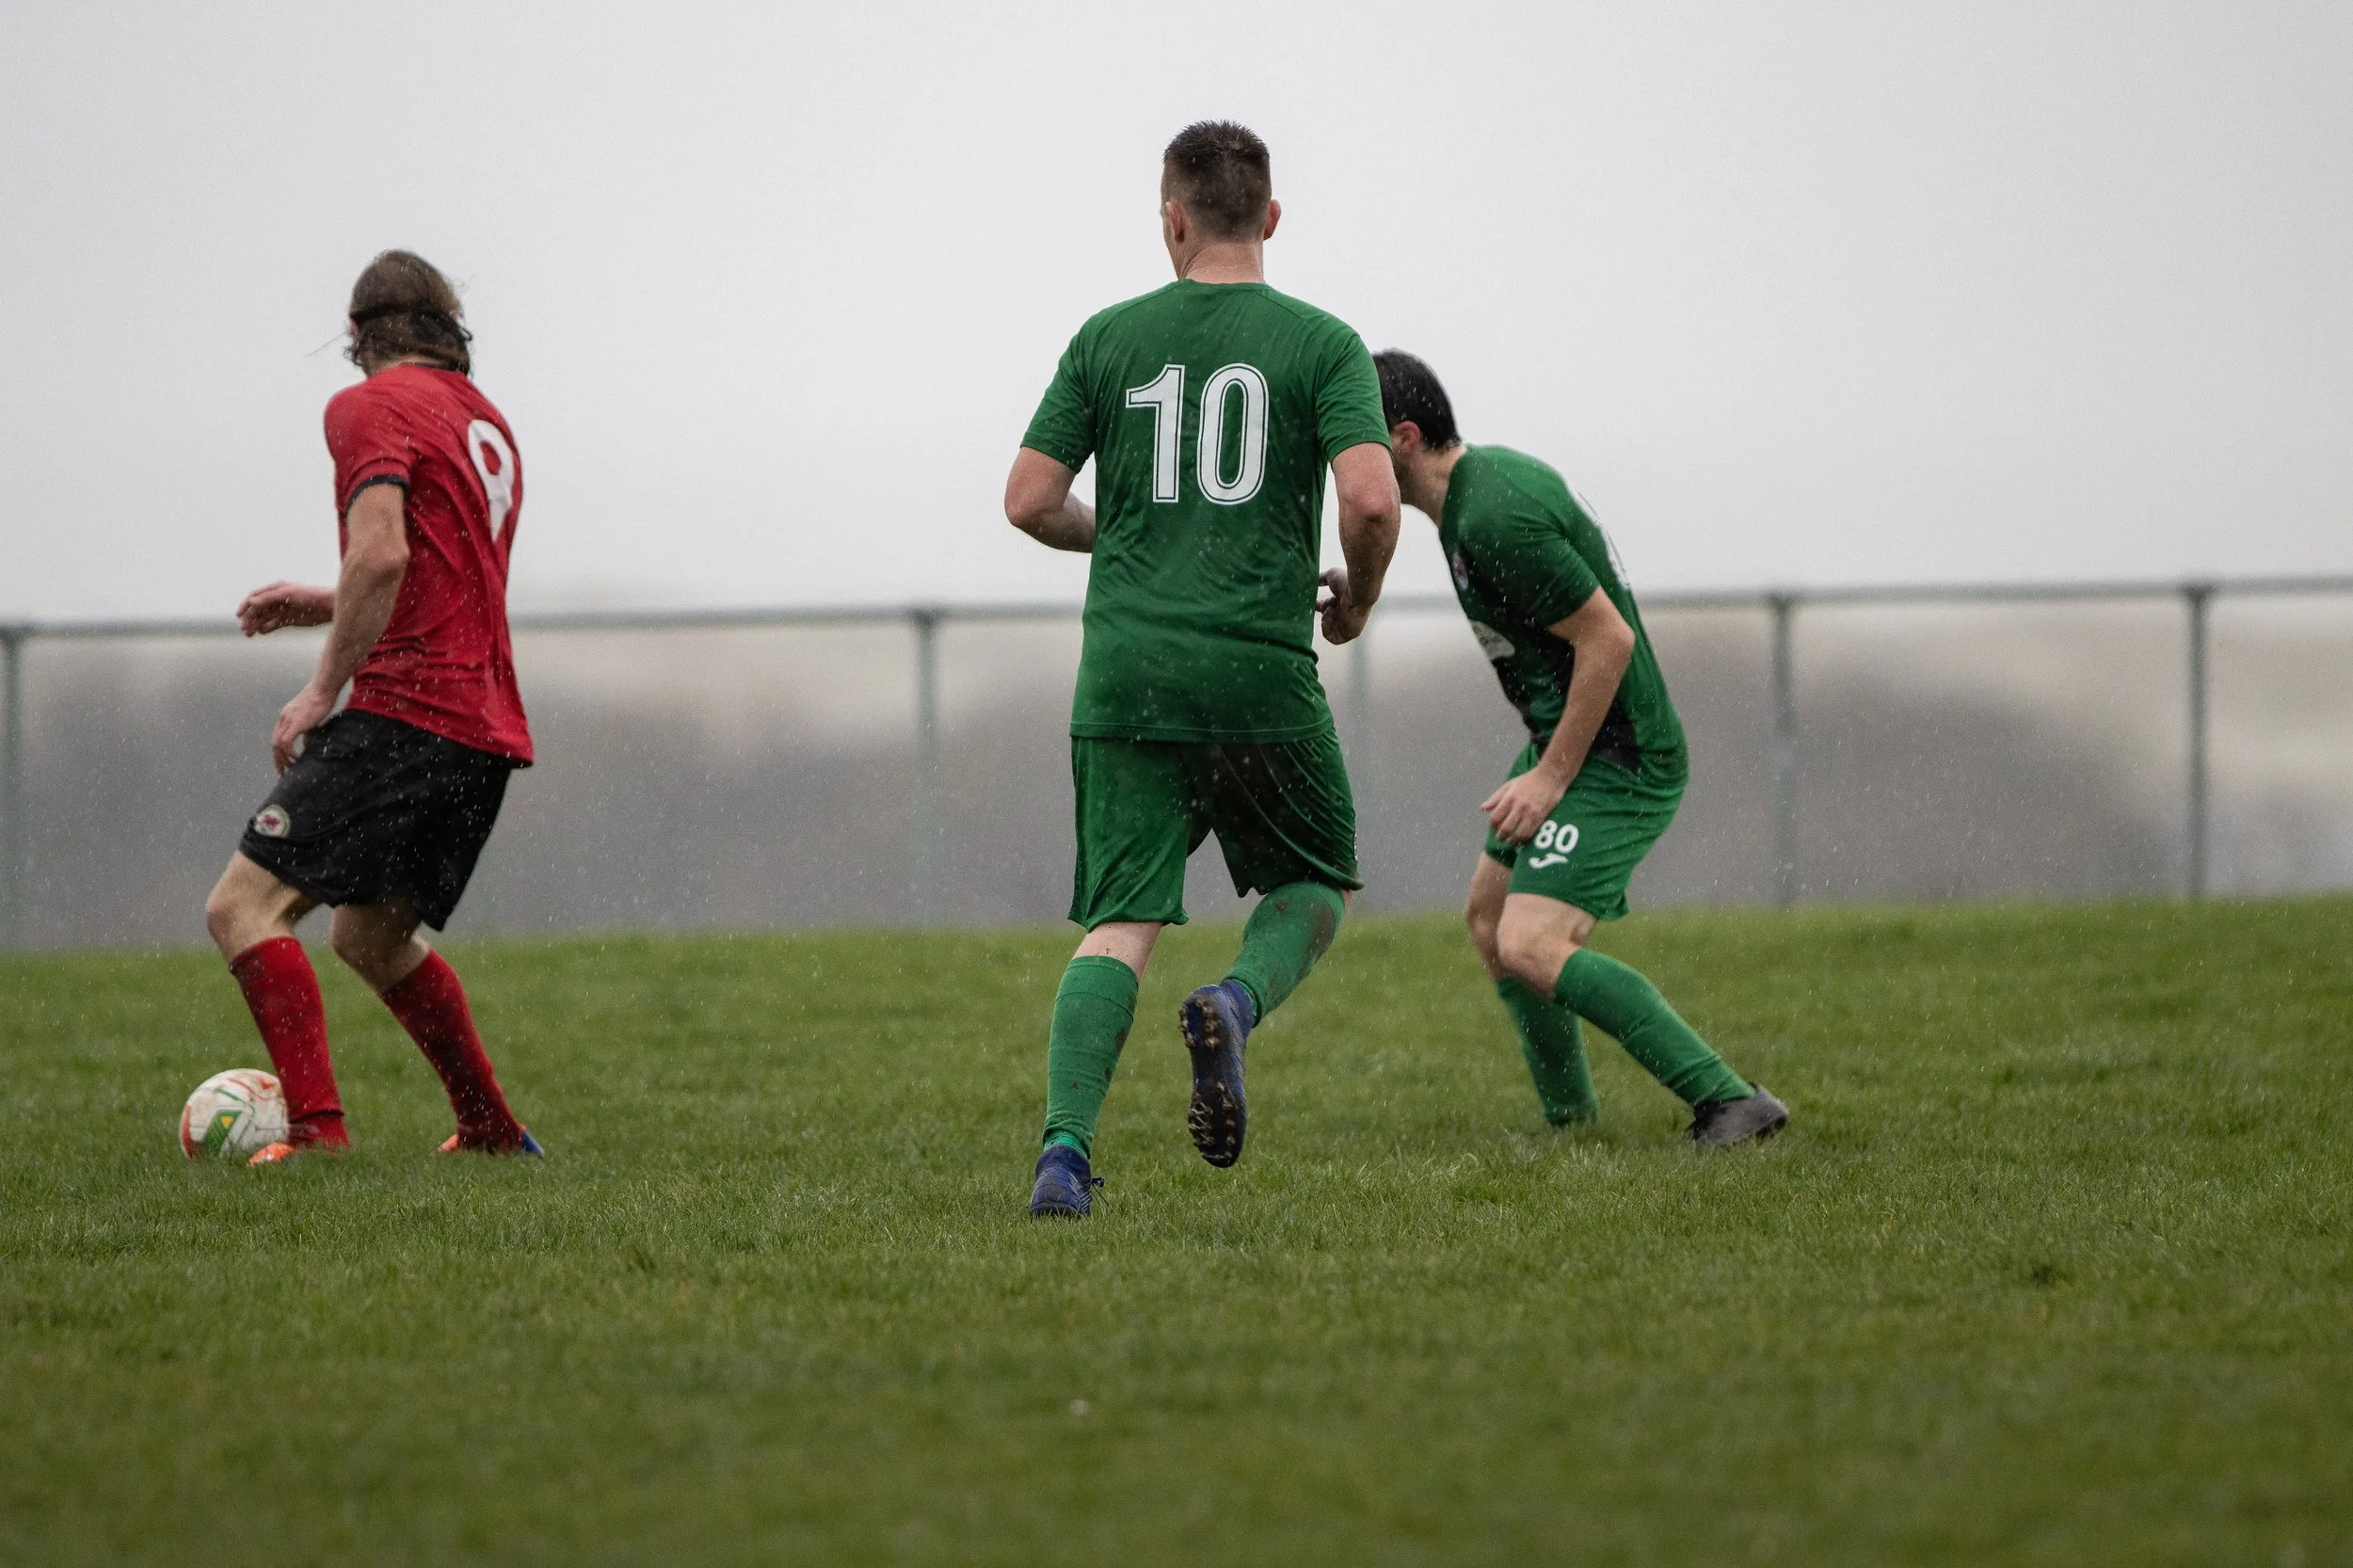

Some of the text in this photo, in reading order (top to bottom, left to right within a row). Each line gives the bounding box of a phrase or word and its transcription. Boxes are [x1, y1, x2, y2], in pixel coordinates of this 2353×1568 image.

[468, 419, 514, 543] 9
[1126, 363, 1270, 505] 10
[1534, 820, 1579, 854] 80
